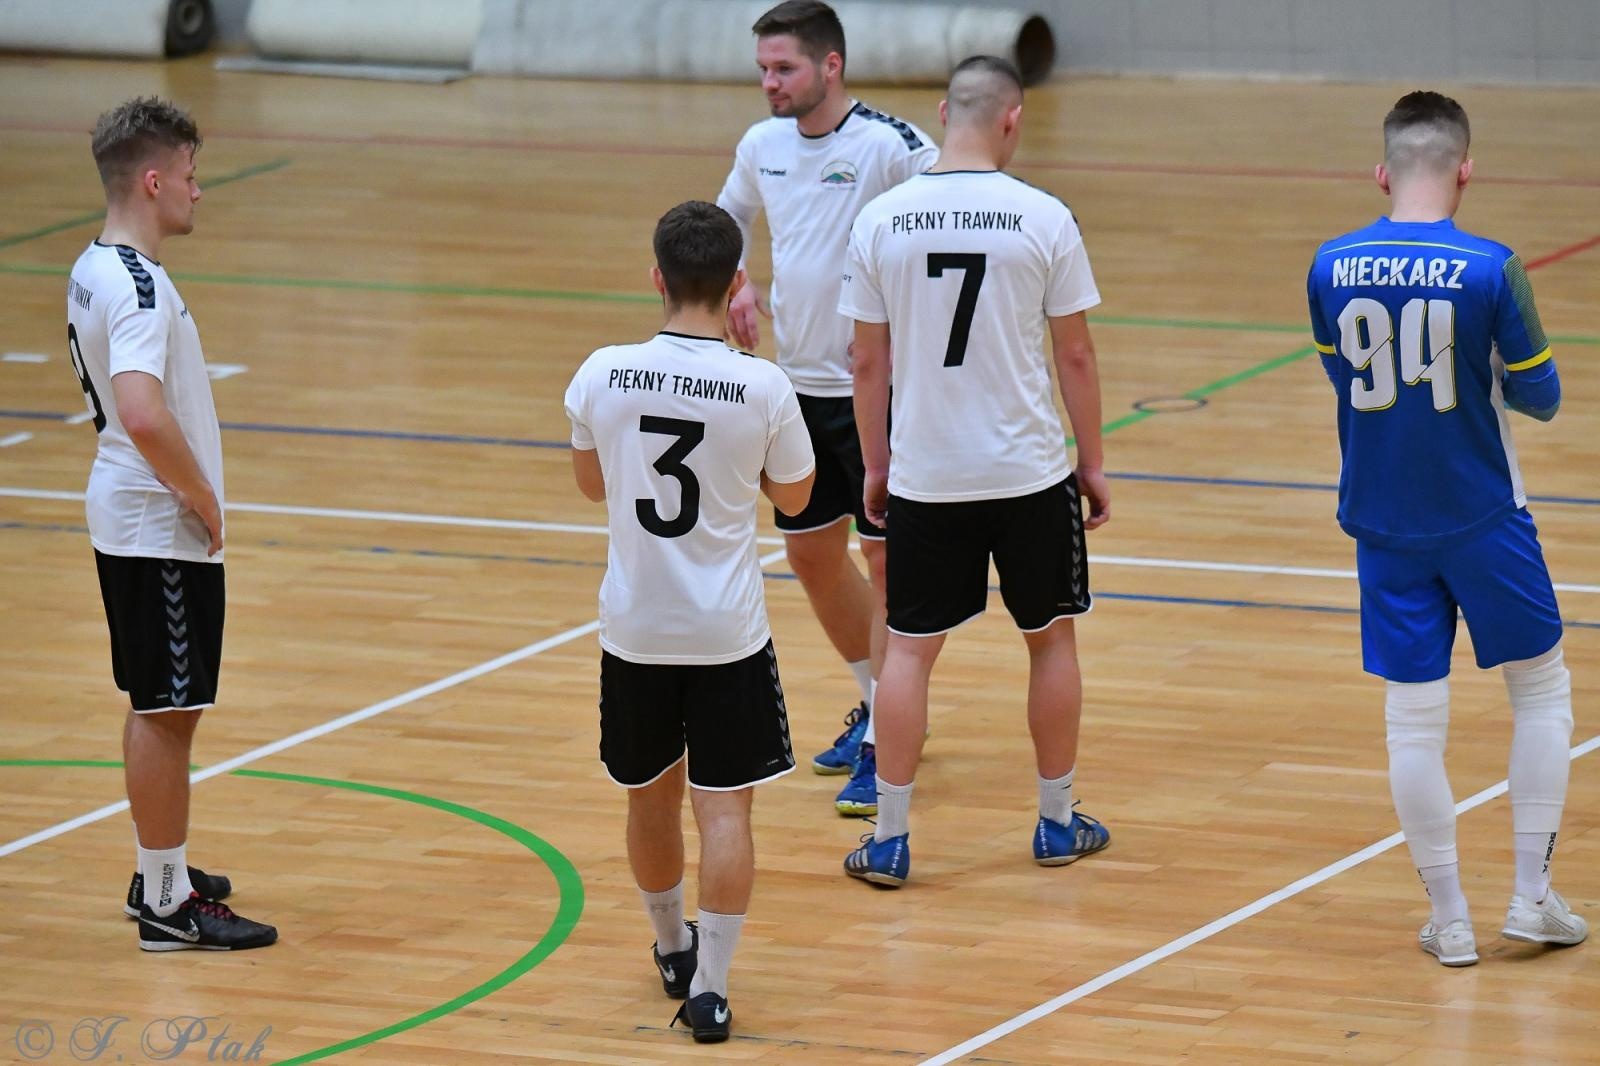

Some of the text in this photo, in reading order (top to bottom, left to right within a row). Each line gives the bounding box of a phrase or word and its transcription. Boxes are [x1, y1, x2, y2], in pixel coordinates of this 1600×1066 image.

[892, 211, 1023, 235] PIĘKNY TRAWNIK
[1332, 256, 1468, 289] NIECKARZ
[927, 252, 986, 368] 7
[1337, 297, 1457, 413] 94
[68, 323, 107, 434] 9
[608, 369, 747, 404] PIĘKNY TRAWNIK
[635, 415, 705, 538] 3
